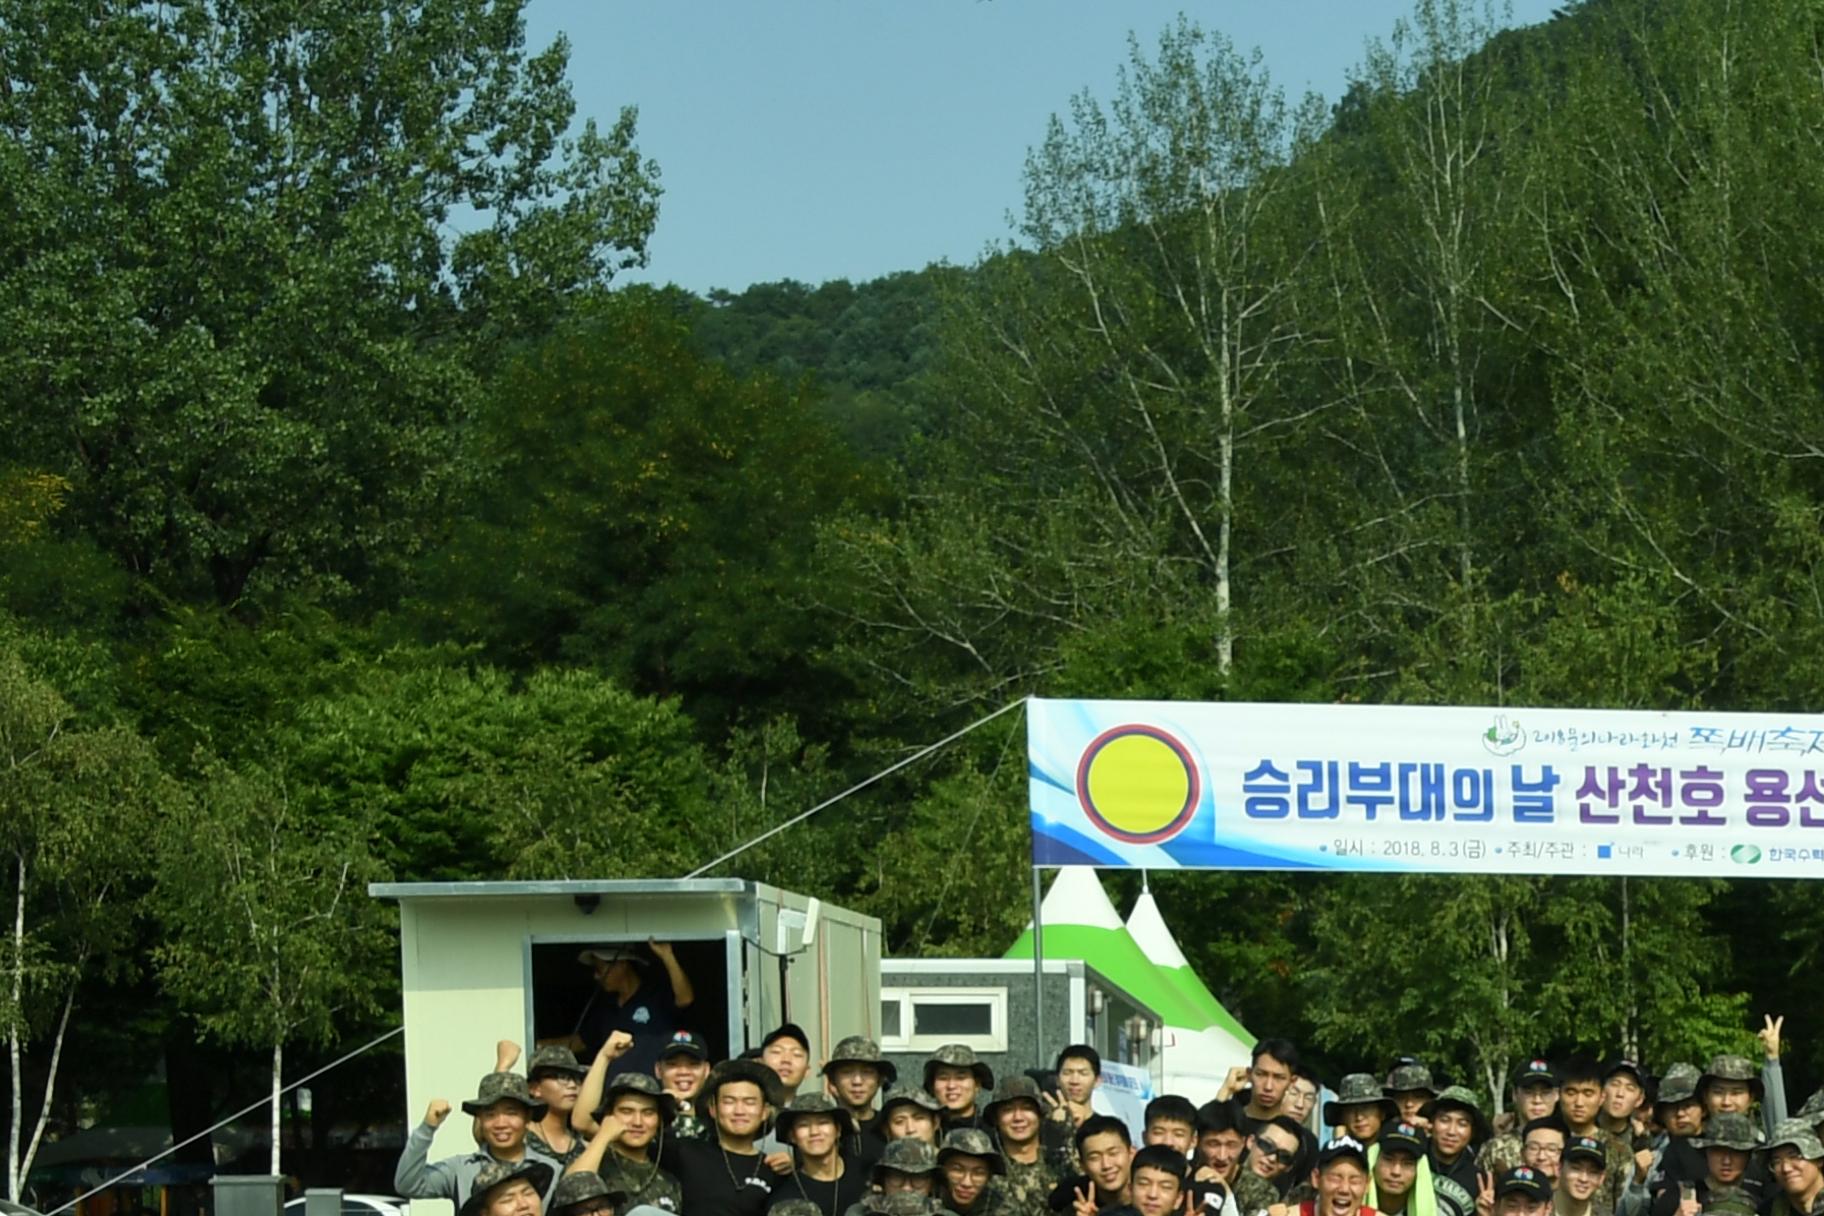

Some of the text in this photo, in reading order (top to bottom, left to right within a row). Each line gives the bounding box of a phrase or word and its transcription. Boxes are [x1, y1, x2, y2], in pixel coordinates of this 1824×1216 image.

[1242, 759, 1494, 822] 승리부대의
[1511, 764, 1561, 825] 날
[1575, 762, 1728, 827] 산천호
[1334, 839, 1363, 858] 일시
[1508, 841, 1575, 860] 주최/주관
[1685, 843, 1714, 861] 후원
